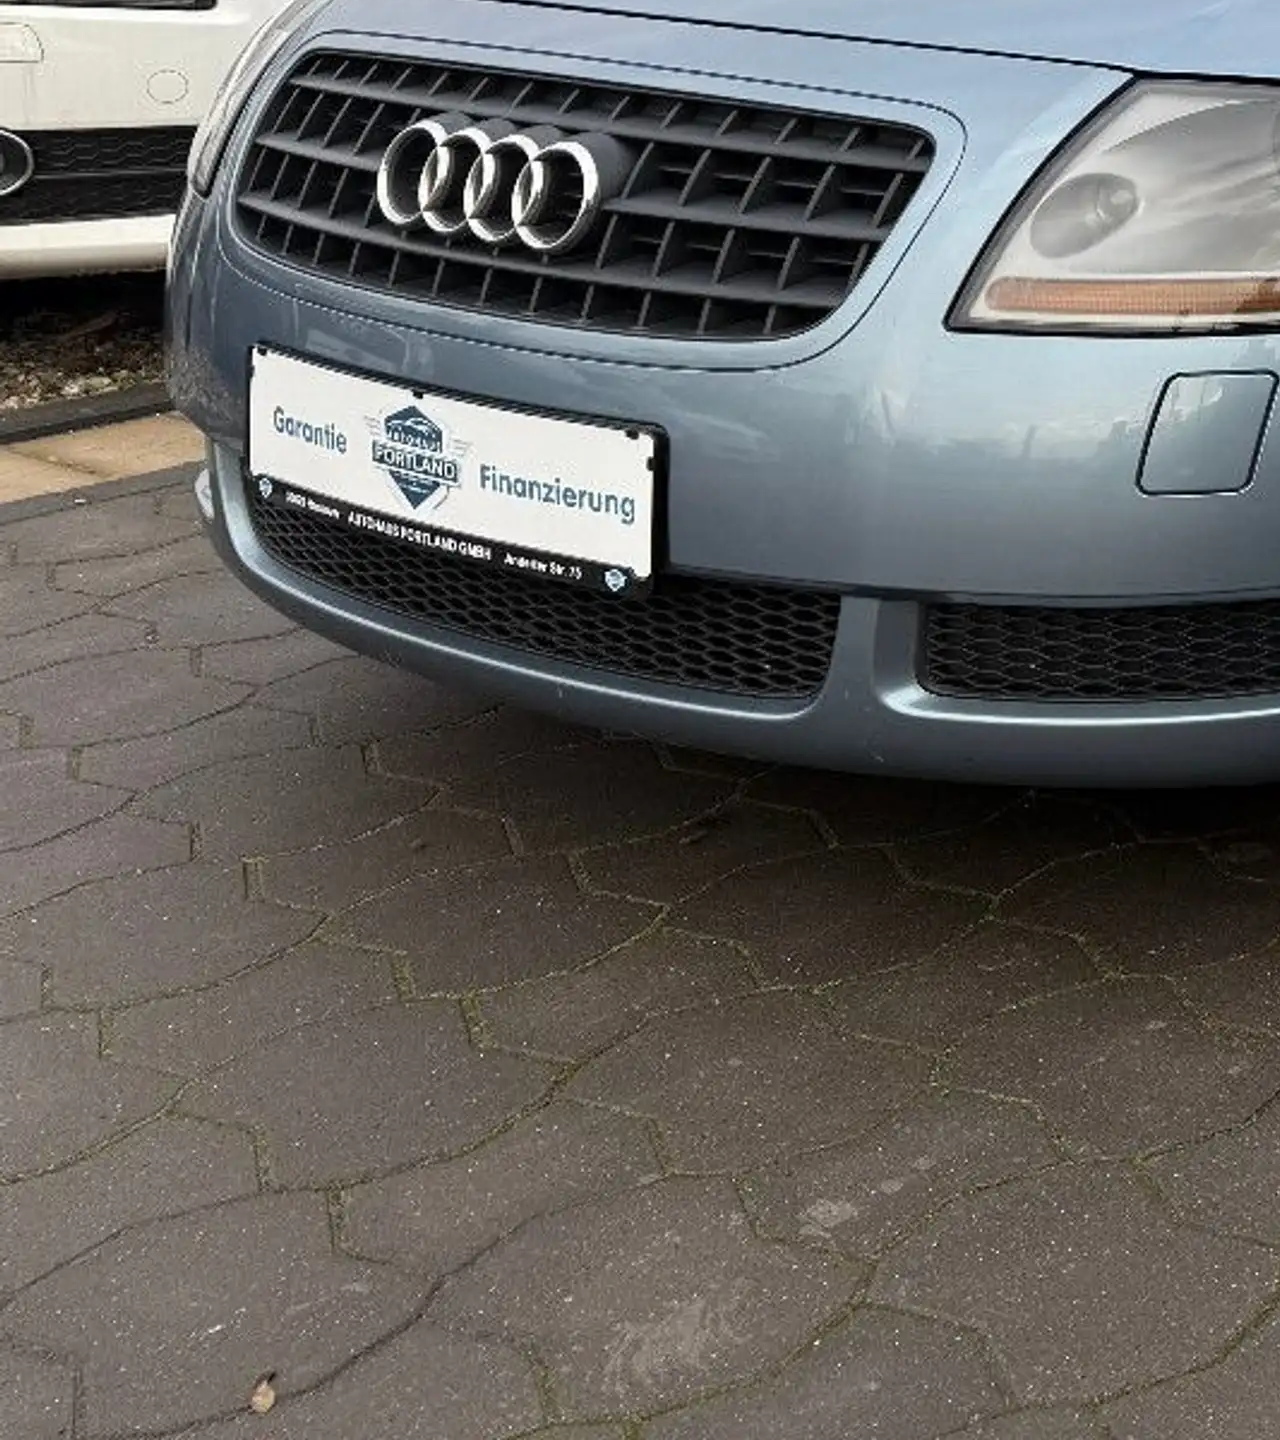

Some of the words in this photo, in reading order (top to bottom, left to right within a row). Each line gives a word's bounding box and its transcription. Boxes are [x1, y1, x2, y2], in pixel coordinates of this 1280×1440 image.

[273, 405, 349, 454] Garantie
[376, 444, 457, 479] PORTLAND
[479, 463, 636, 525] Finanzierung
